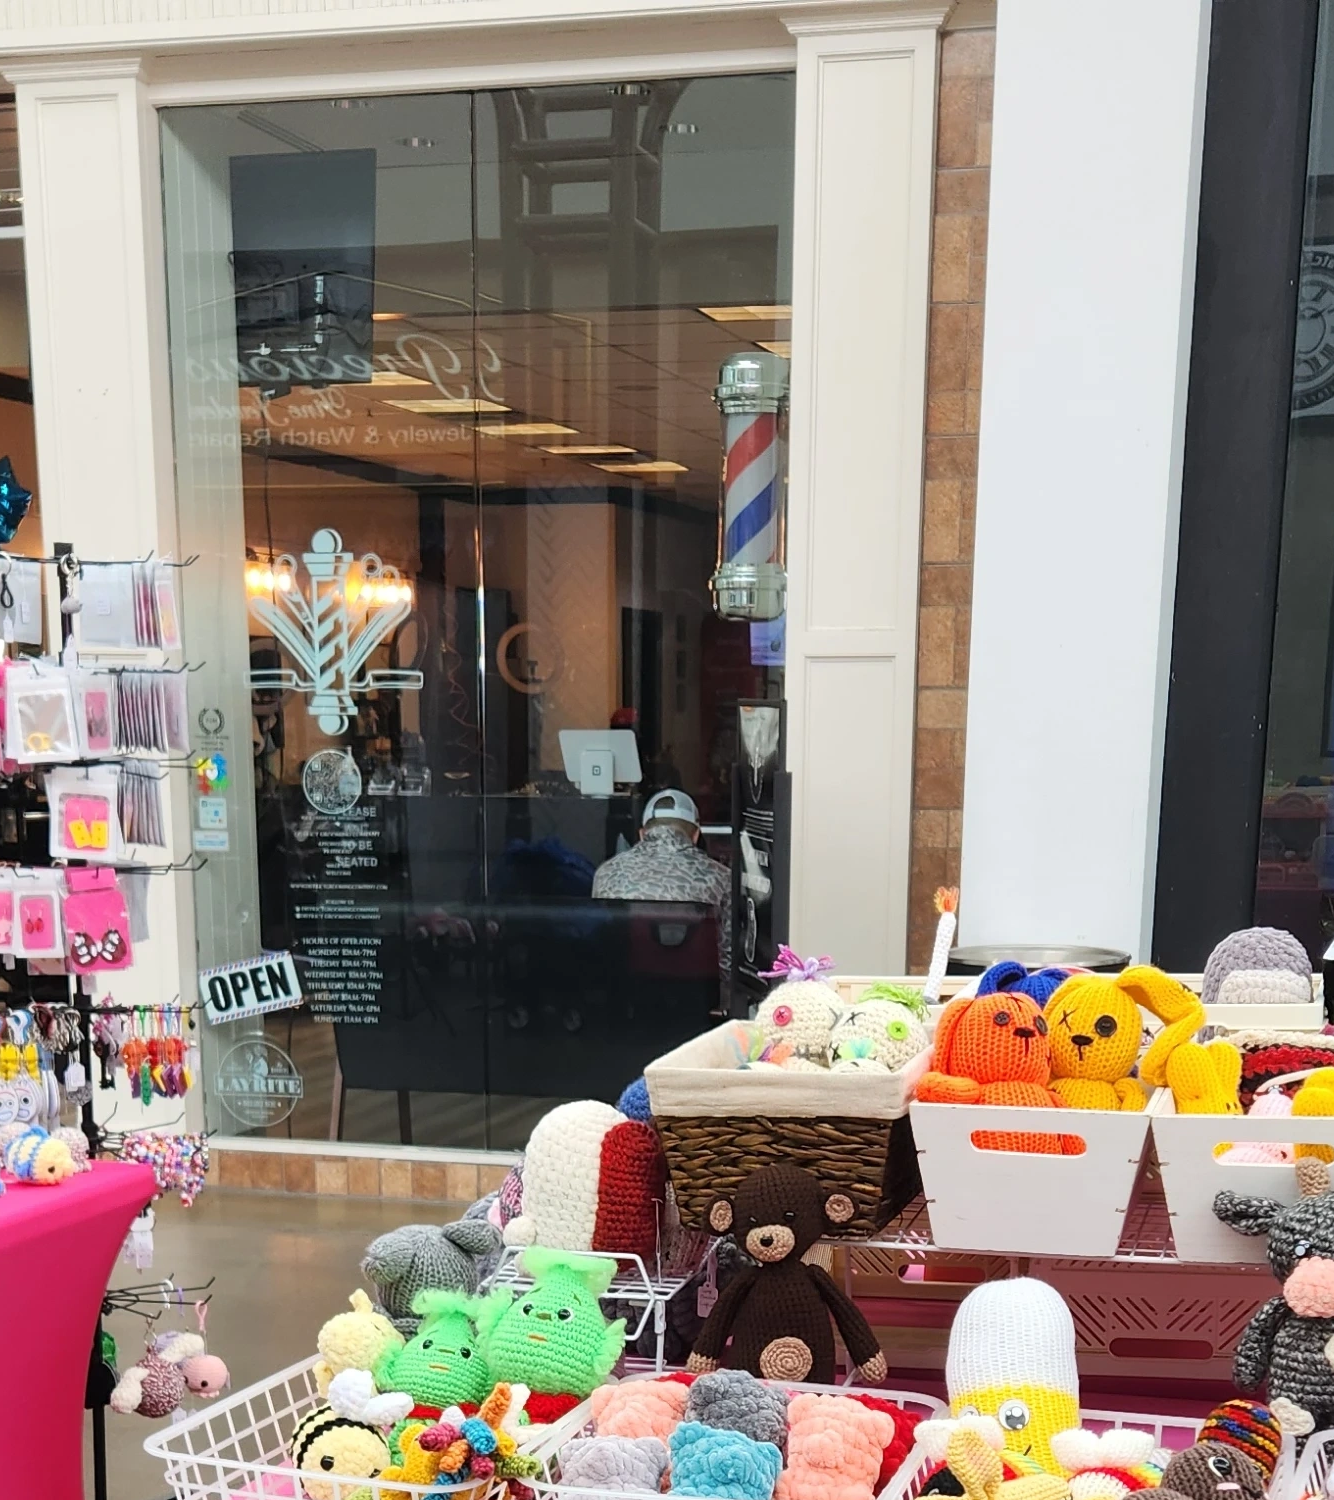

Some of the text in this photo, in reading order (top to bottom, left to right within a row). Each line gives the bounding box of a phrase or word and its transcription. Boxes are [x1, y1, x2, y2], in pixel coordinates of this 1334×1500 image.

[358, 840, 374, 851] BE
[336, 855, 378, 867] SEATED
[303, 937, 382, 945] HOURS OF OPERATION
[208, 962, 293, 1013] OPEN
[218, 1077, 301, 1094] LAYRITE
